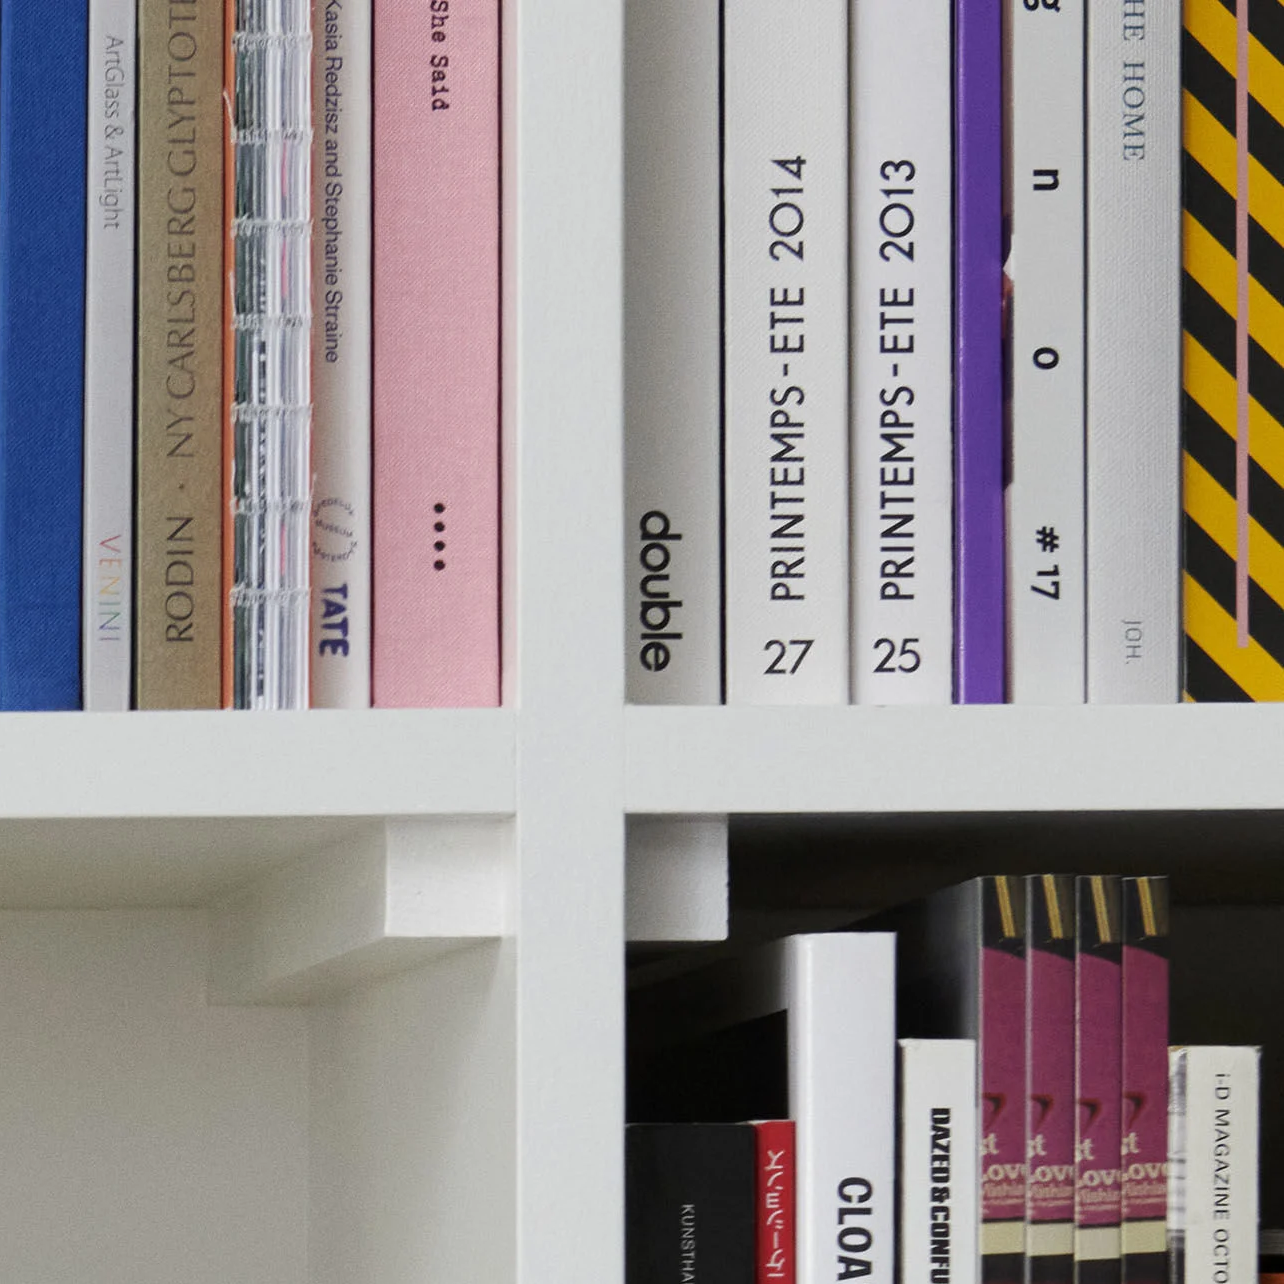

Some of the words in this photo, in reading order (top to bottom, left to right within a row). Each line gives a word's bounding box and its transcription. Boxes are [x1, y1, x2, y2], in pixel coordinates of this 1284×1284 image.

[429, 0, 450, 43] She
[103, 35, 125, 119] ArtGlass
[325, 56, 344, 133] Redzisz
[429, 55, 450, 110] Said
[1123, 62, 1145, 161] HOME
[104, 124, 125, 139] &
[323, 139, 344, 178] and
[98, 147, 124, 230] ArtLight
[768, 155, 807, 261] 2014
[878, 159, 916, 262] 2013
[319, 182, 344, 286] Stephanie
[165, 187, 196, 400] CARLSBERG
[323, 290, 344, 364] Straine
[165, 409, 194, 457] NY
[98, 534, 122, 641] VENINI
[164, 516, 194, 643] RODIN
[639, 510, 684, 671] double
[318, 586, 350, 656] TATE
[763, 639, 815, 676] 27
[872, 637, 922, 673] 25
[1213, 1073, 1230, 1100] i-D
[1213, 1109, 1230, 1220] MAGAZINE
